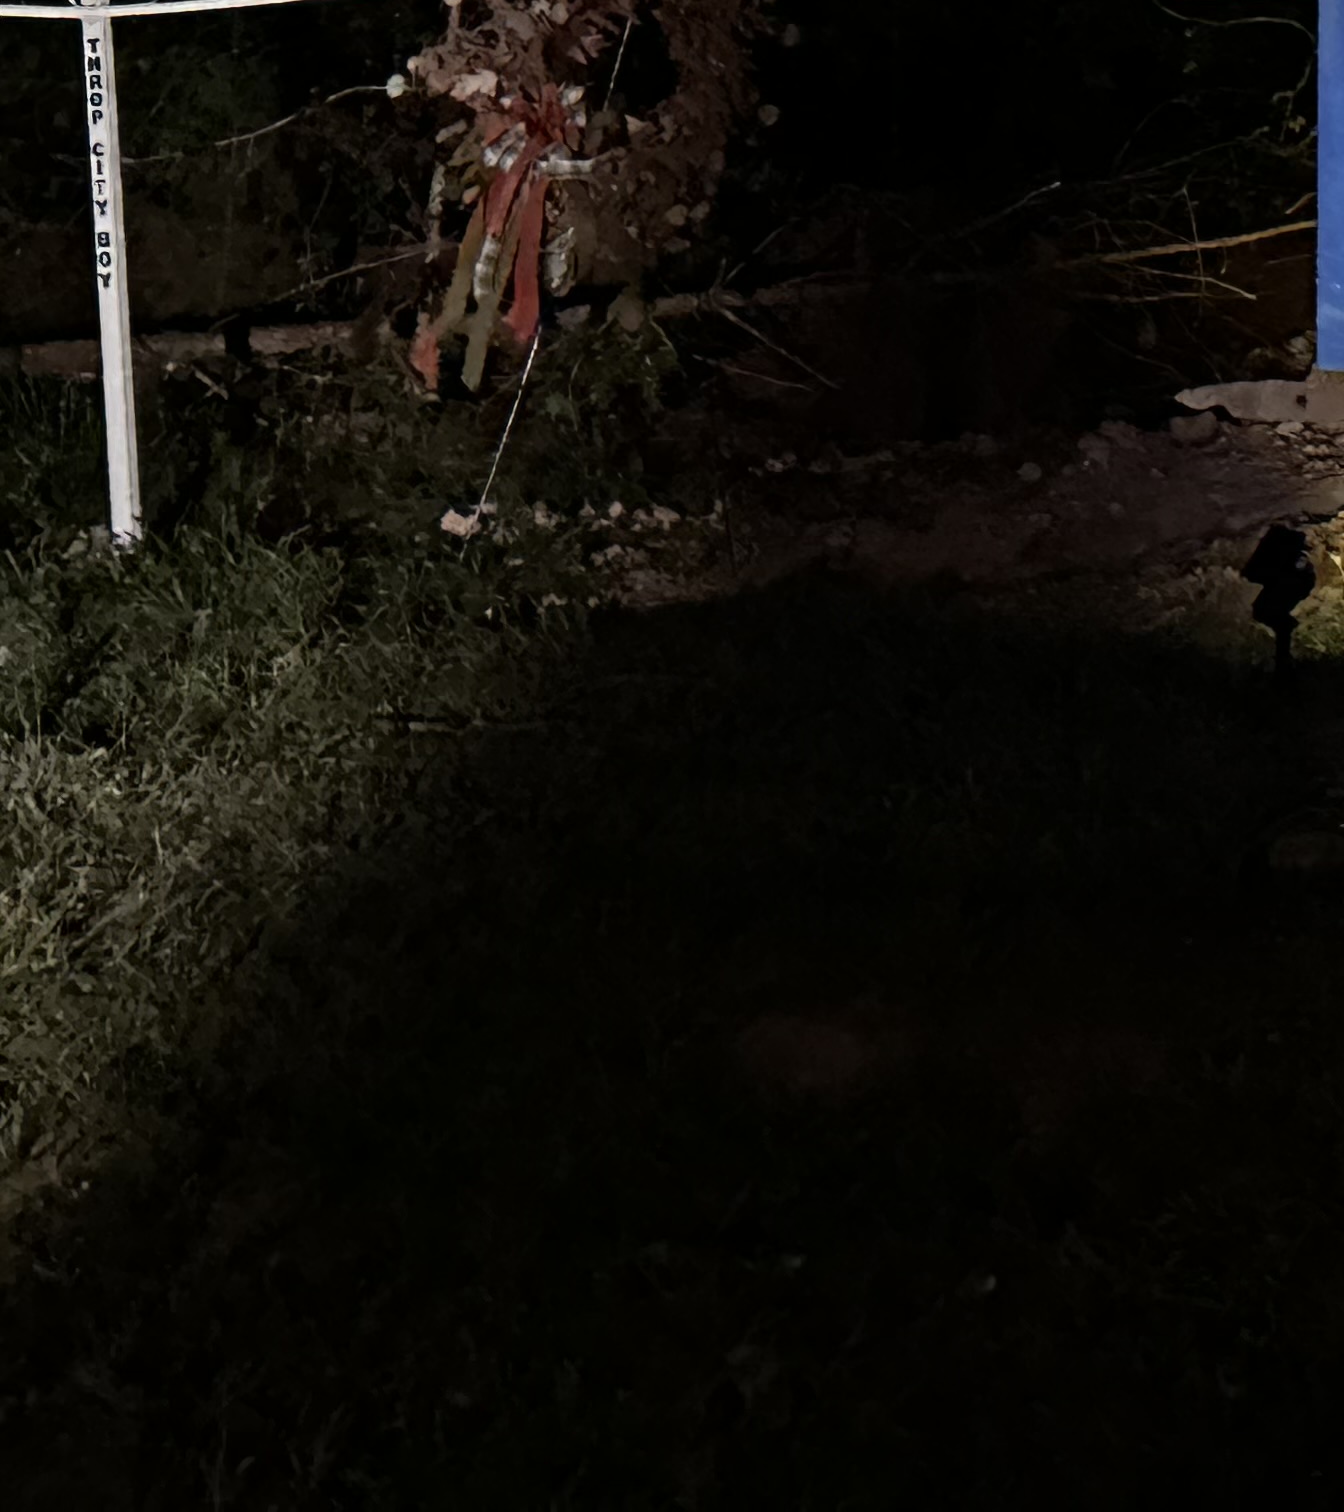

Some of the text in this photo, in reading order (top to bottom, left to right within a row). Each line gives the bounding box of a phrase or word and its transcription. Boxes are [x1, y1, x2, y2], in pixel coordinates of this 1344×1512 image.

[87, 38, 111, 288] THROP CITY BOY
